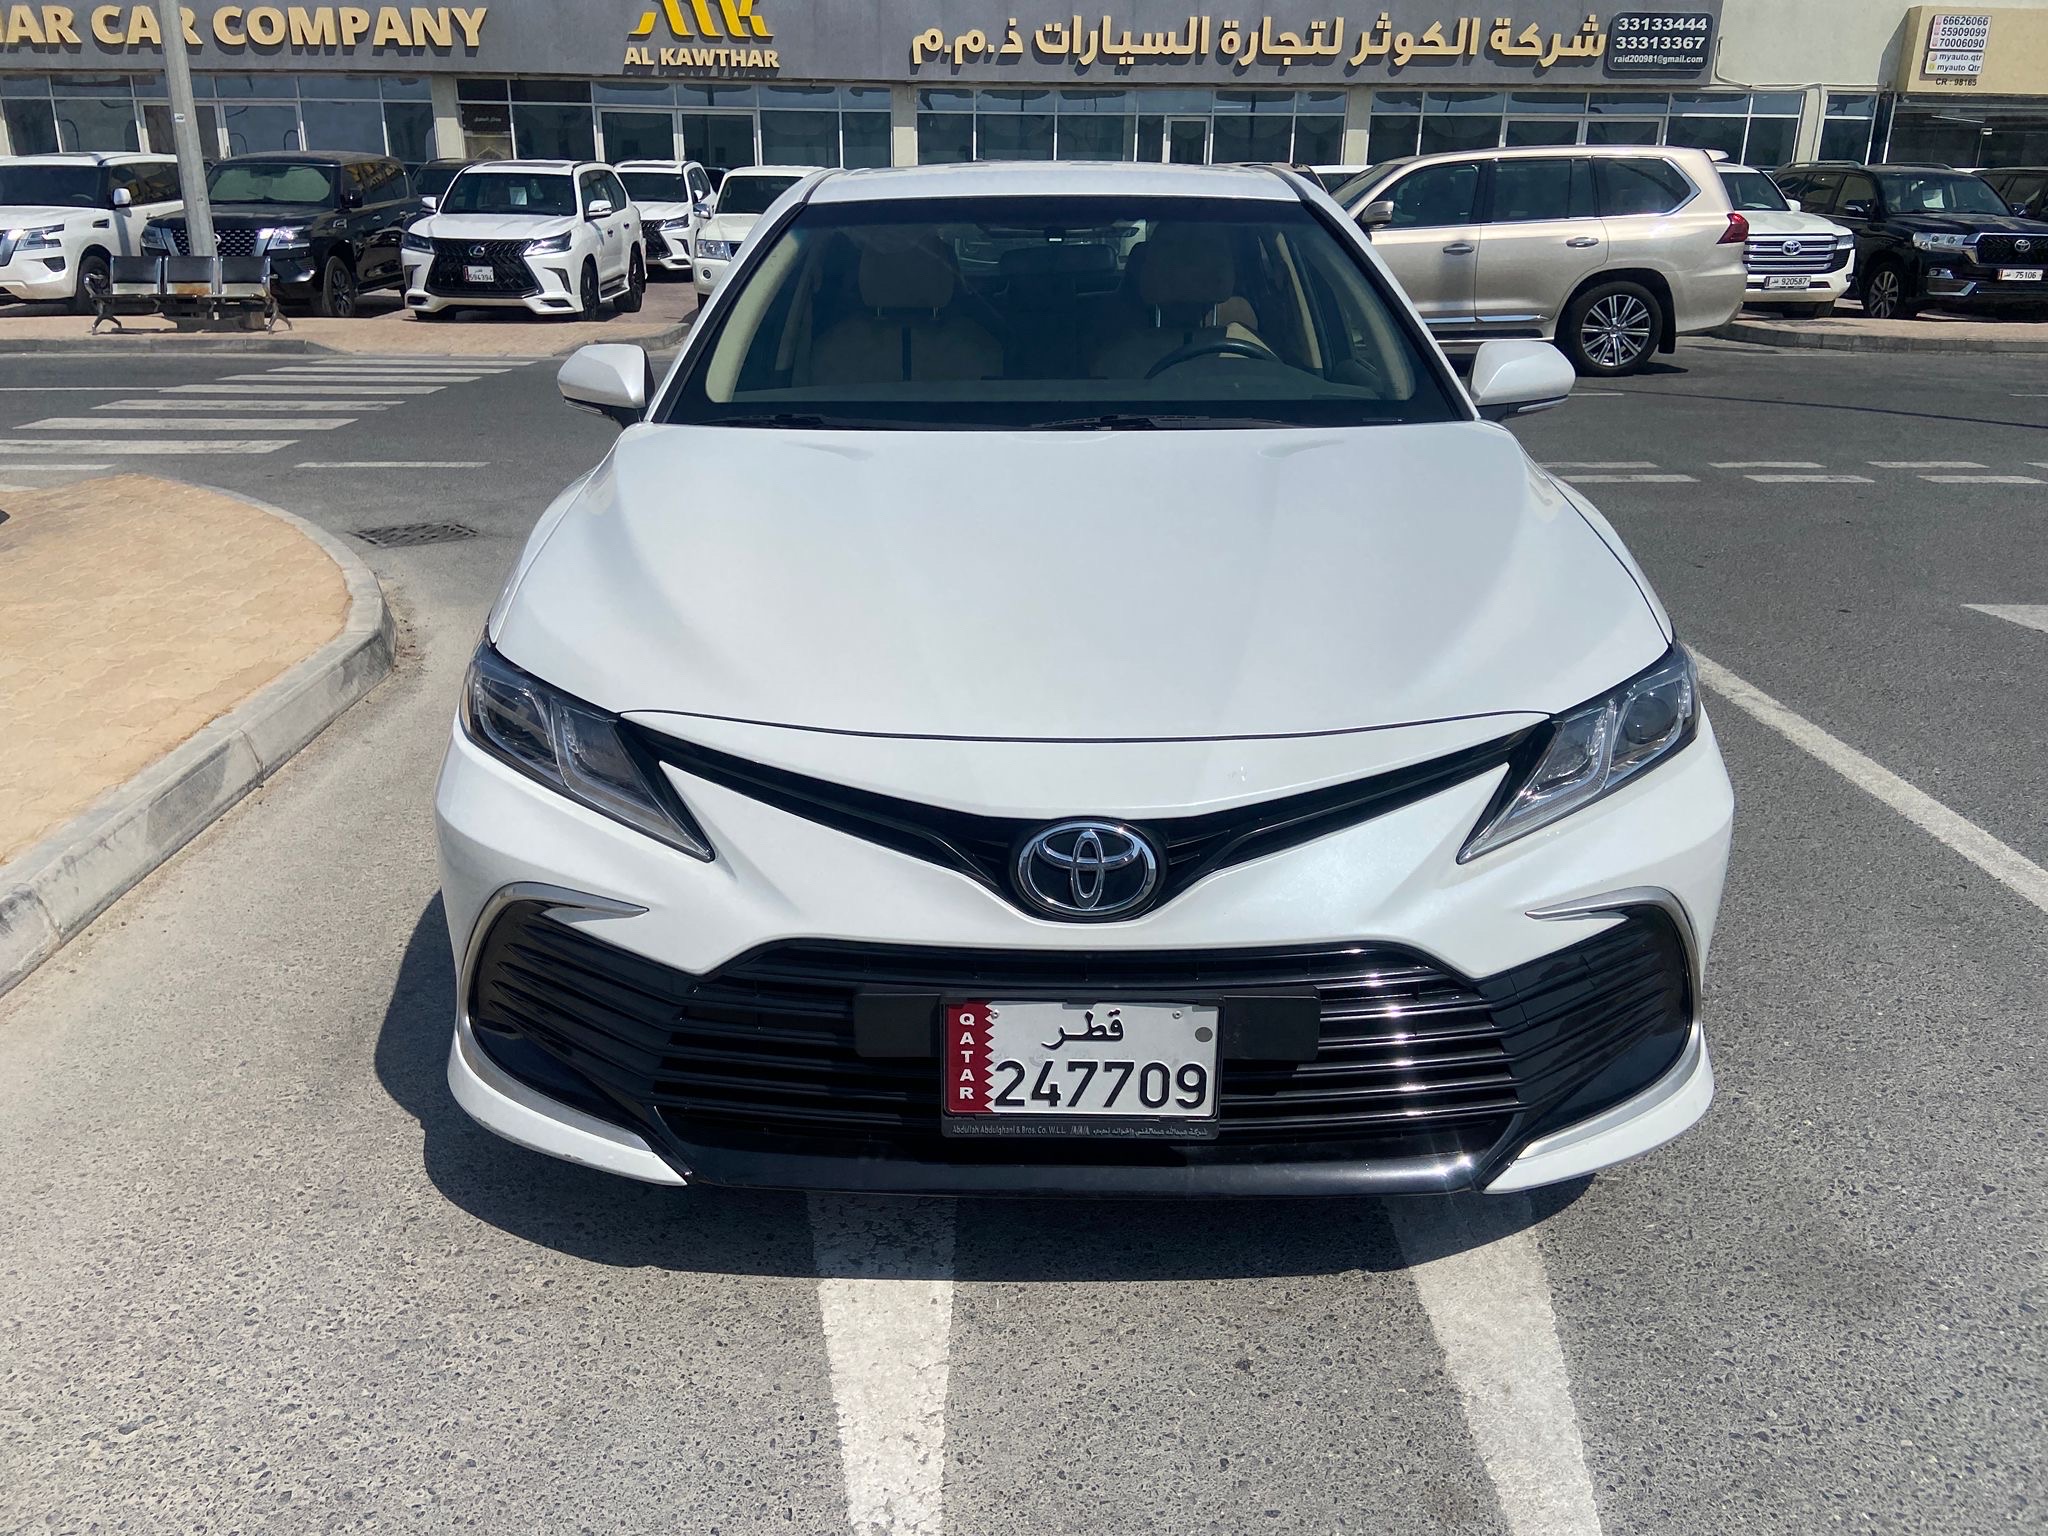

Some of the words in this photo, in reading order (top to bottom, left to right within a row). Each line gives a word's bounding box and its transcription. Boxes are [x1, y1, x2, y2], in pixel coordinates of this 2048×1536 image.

[0, 4, 82, 44] AR
[90, 5, 204, 45] CAR
[212, 6, 488, 46] COMPANY
[1617, 17, 1708, 31] 33133444
[1940, 27, 1987, 37] 55909099
[1942, 15, 1989, 26] 66626066
[1034, 14, 1211, 66] السيارات
[1220, 15, 1345, 67] لتجارة
[1350, 11, 1482, 67] الكوثر
[1490, 13, 1607, 68] شركة
[1615, 36, 1706, 50] 33313367
[1939, 38, 1985, 48] 70006090
[624, 47, 655, 65] AL
[660, 48, 780, 67] KAWTHAR
[1613, 54, 1704, 65] raid200981@gmail.com
[1935, 78, 1948, 86] CR
[1040, 1008, 1125, 1051] قطر
[958, 1012, 976, 1101] QATAR
[993, 1059, 1208, 1110] 247709
